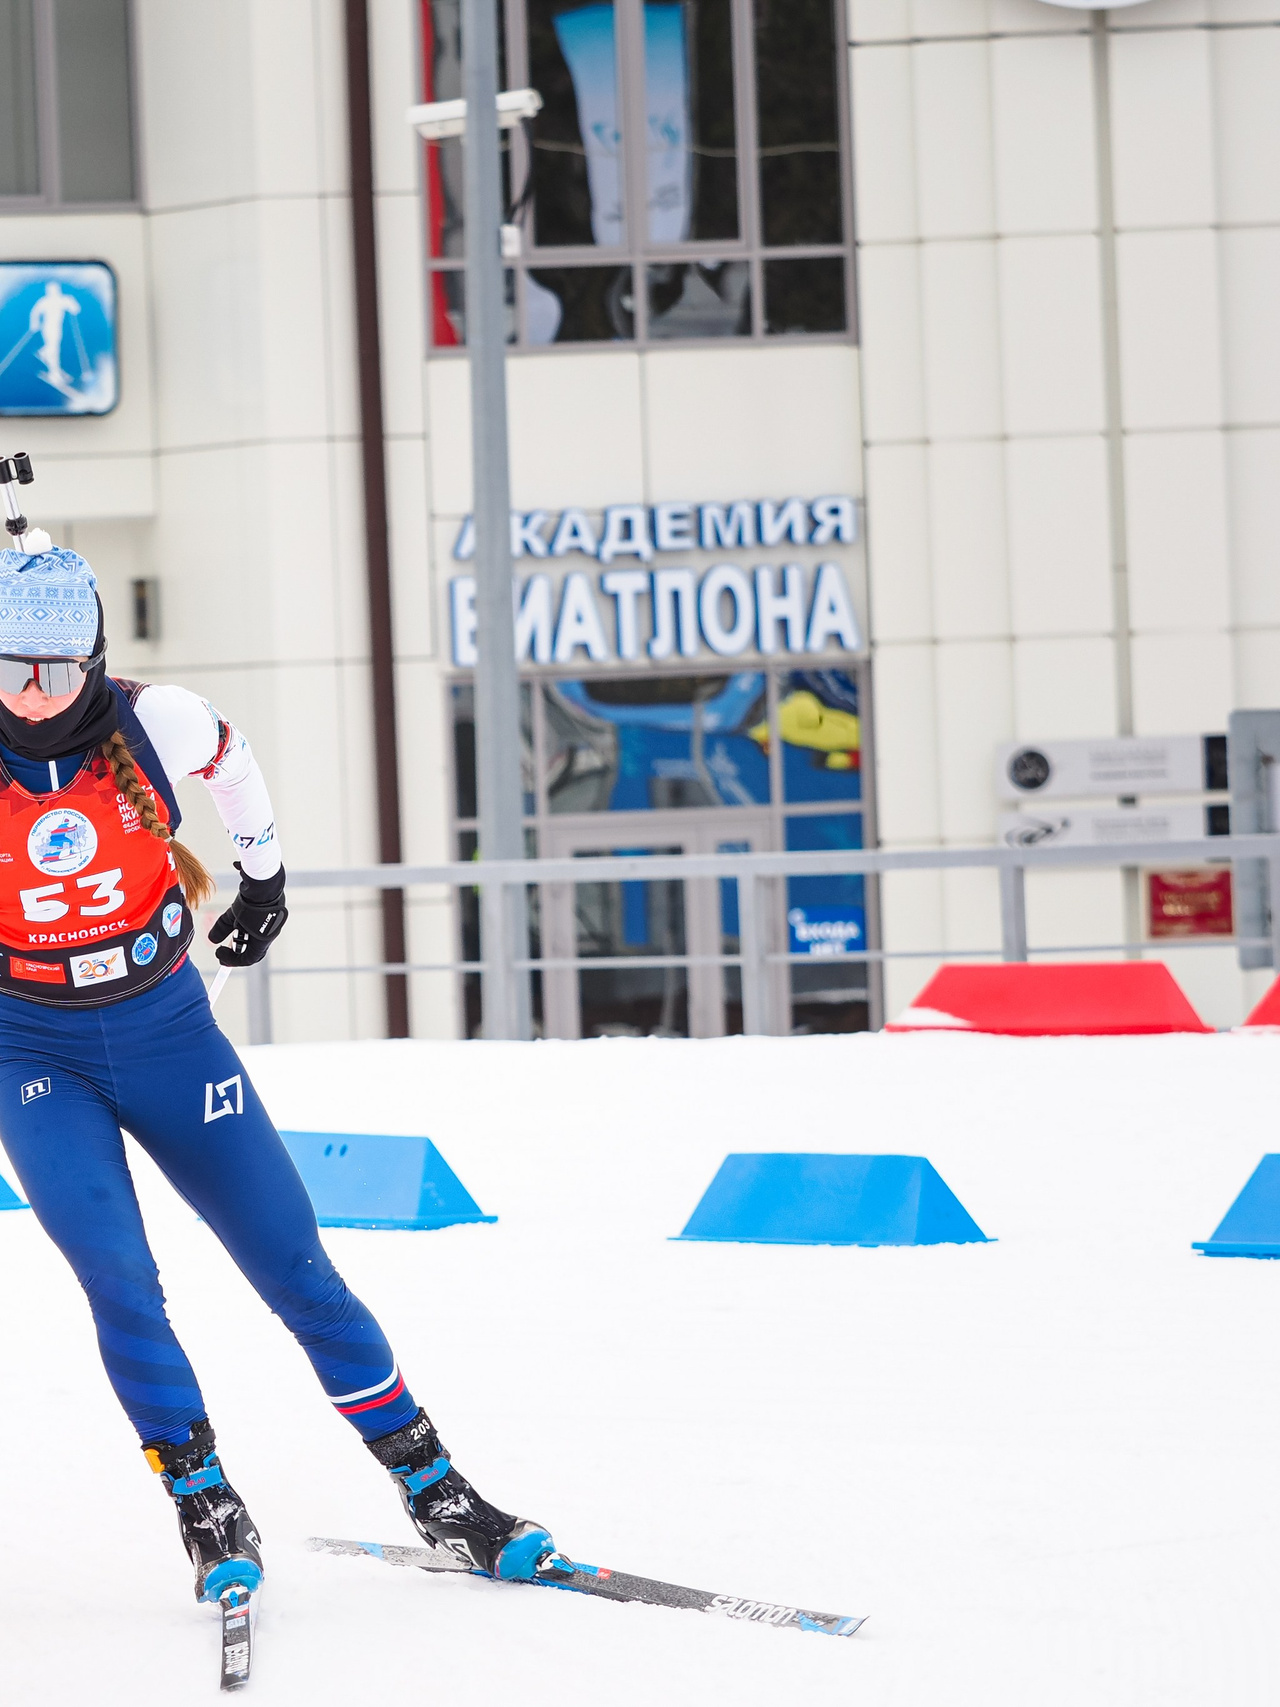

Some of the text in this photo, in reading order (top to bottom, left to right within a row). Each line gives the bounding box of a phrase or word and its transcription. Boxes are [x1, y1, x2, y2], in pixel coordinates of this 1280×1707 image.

[124, 825, 141, 834] ПРОЕК
[18, 868, 125, 922] 53
[28, 919, 129, 944] КРАСНОЯРСК
[410, 1419, 430, 1441] 203
